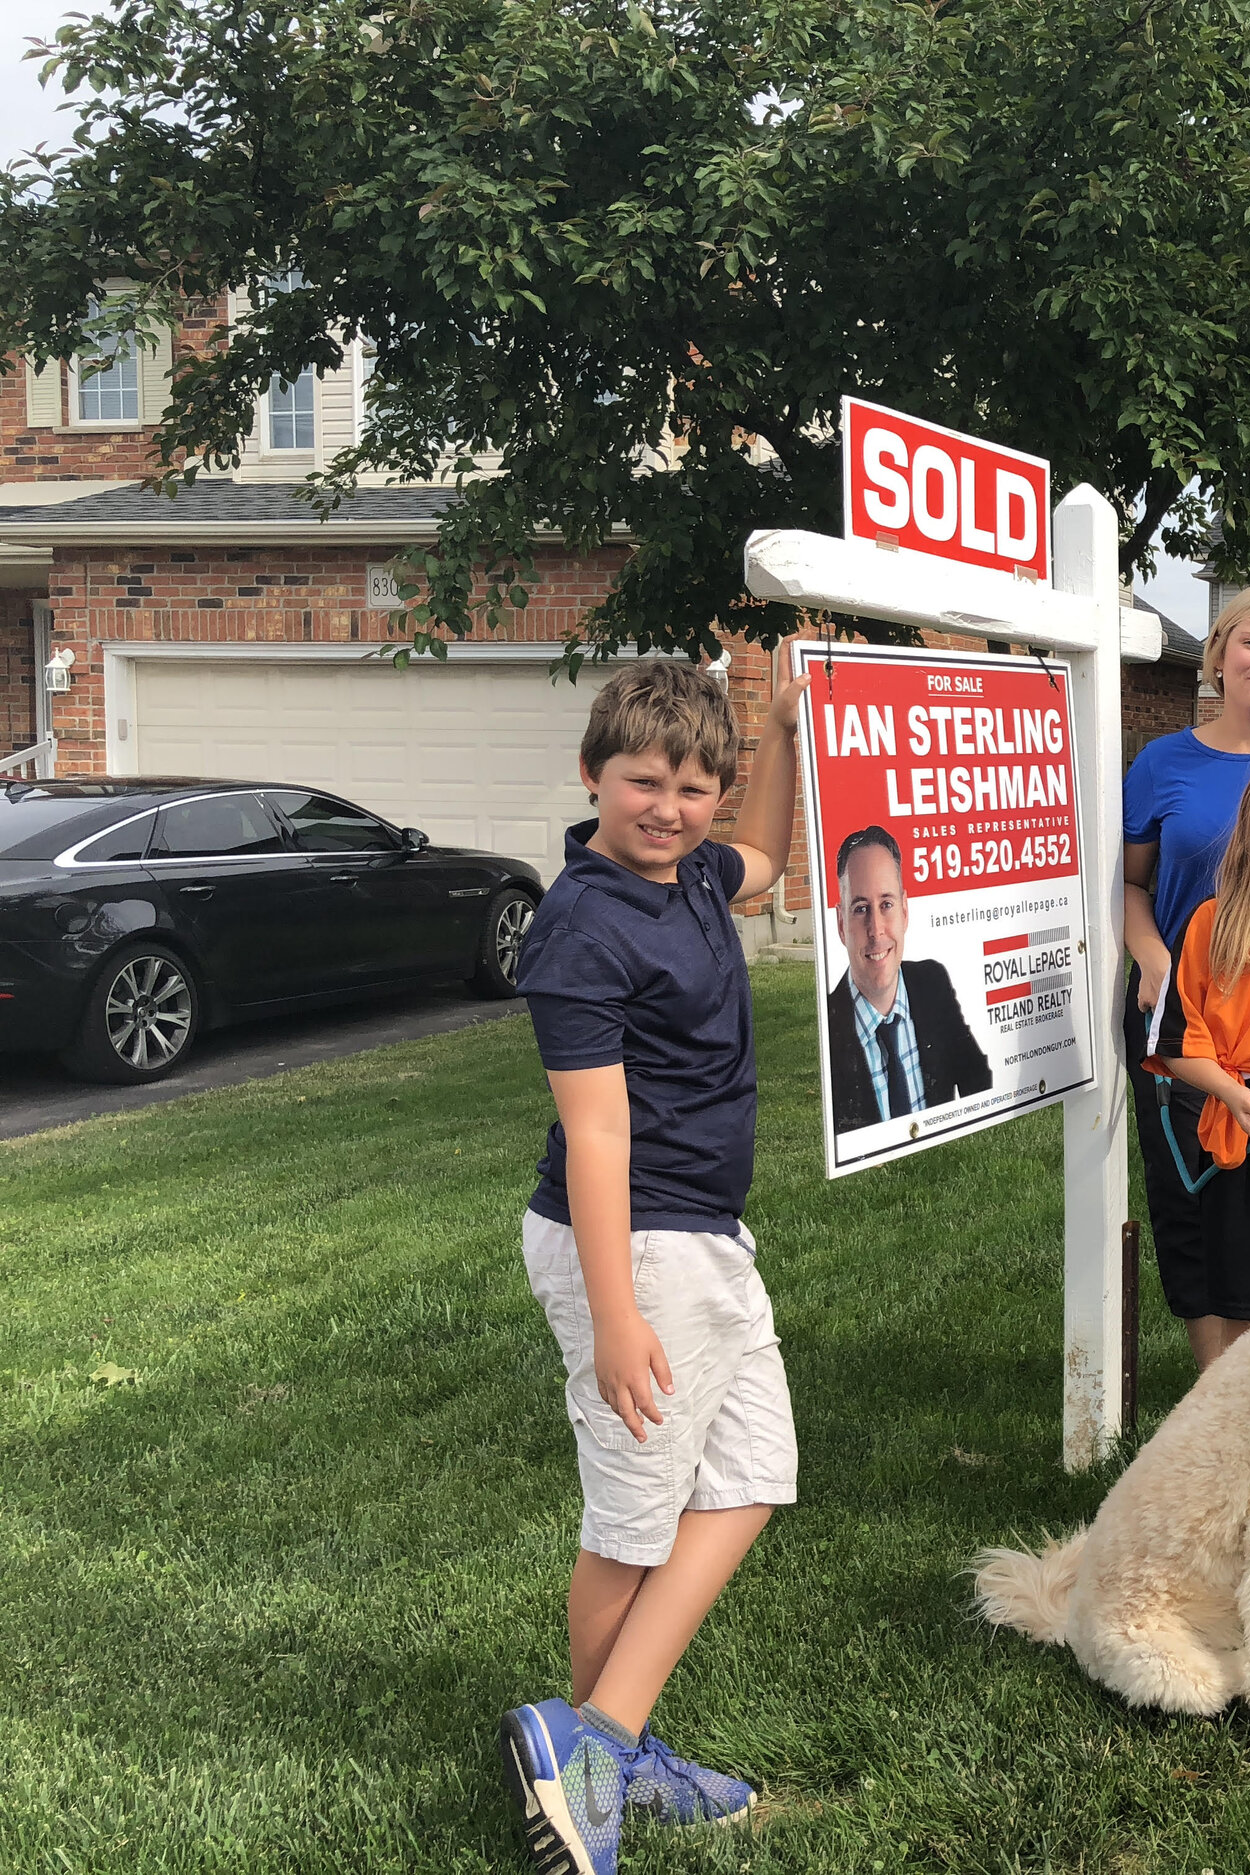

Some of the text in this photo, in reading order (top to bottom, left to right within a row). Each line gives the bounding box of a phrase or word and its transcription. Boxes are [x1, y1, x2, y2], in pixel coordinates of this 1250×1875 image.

[863, 428, 1037, 561] SOLD
[372, 577, 398, 596] 830
[927, 675, 983, 693] FOR SALE
[824, 704, 1064, 756] IAN STERLING
[886, 764, 1068, 817] LEISHMAN
[913, 816, 1069, 839] SALES REPRESENTATIVE
[913, 833, 1072, 882] 519.520.4552
[931, 896, 1069, 928] iansterling@royallepage.ca
[984, 957, 1027, 985] ROYAL
[988, 988, 1073, 1025] TRILAND REALTY
[1000, 1009, 1064, 1034] REAL ESTATE BROKERAGE
[1004, 1037, 1077, 1066] NORTHLONDONGUY.COM
[963, 1102, 981, 1117] OWNED
[981, 1100, 991, 1110] AND
[991, 1092, 1013, 1106] OPERATED
